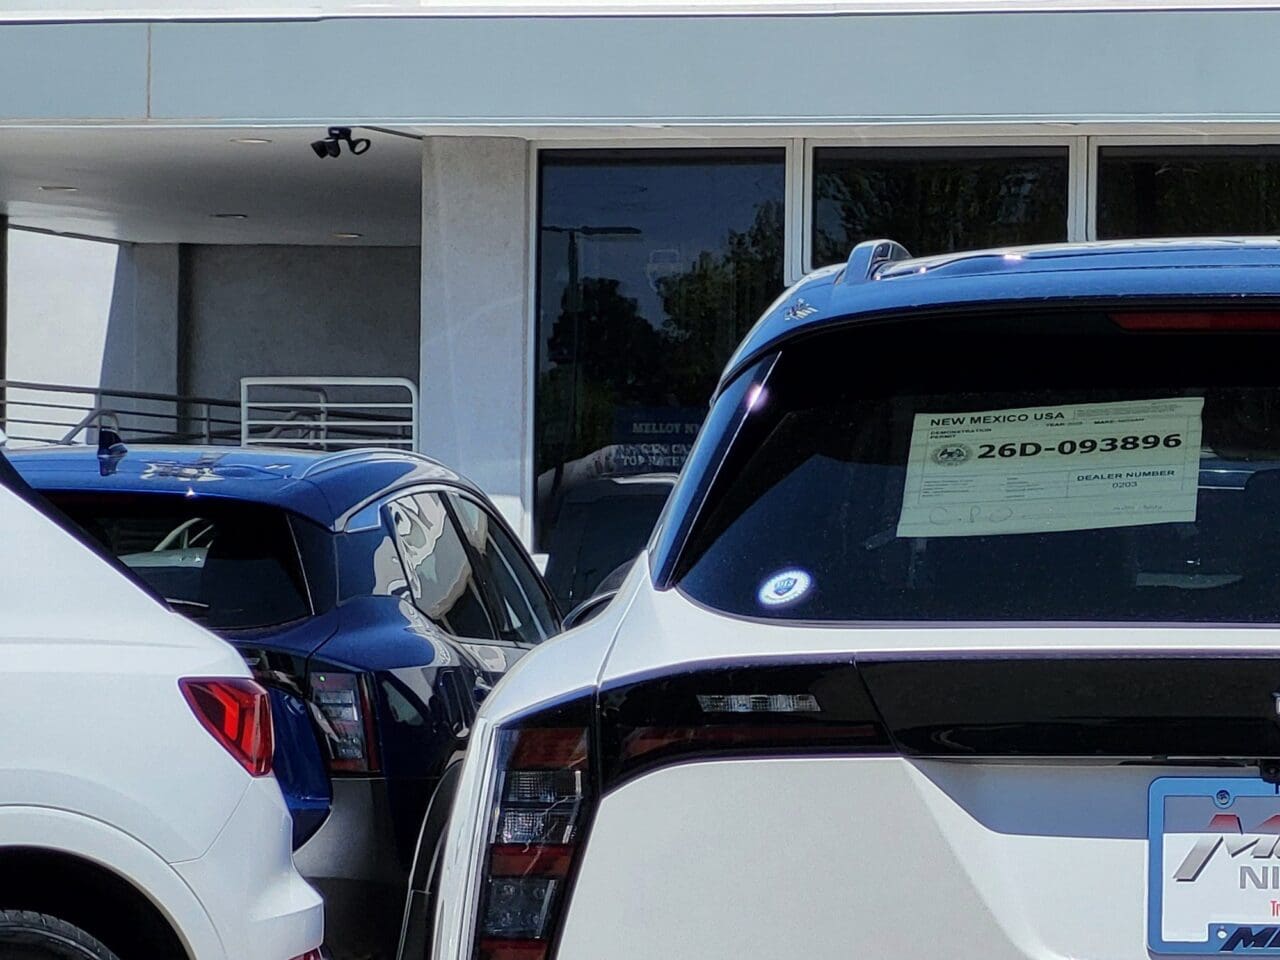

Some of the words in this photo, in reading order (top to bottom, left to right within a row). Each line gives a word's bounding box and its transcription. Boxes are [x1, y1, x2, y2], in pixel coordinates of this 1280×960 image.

[930, 416, 966, 427] NEW
[969, 413, 1029, 425] MEXICO
[1033, 411, 1065, 421] USA
[977, 433, 1183, 460] 26D-093896
[1076, 473, 1123, 482] DEALER
[1125, 469, 1176, 478] NUMBER
